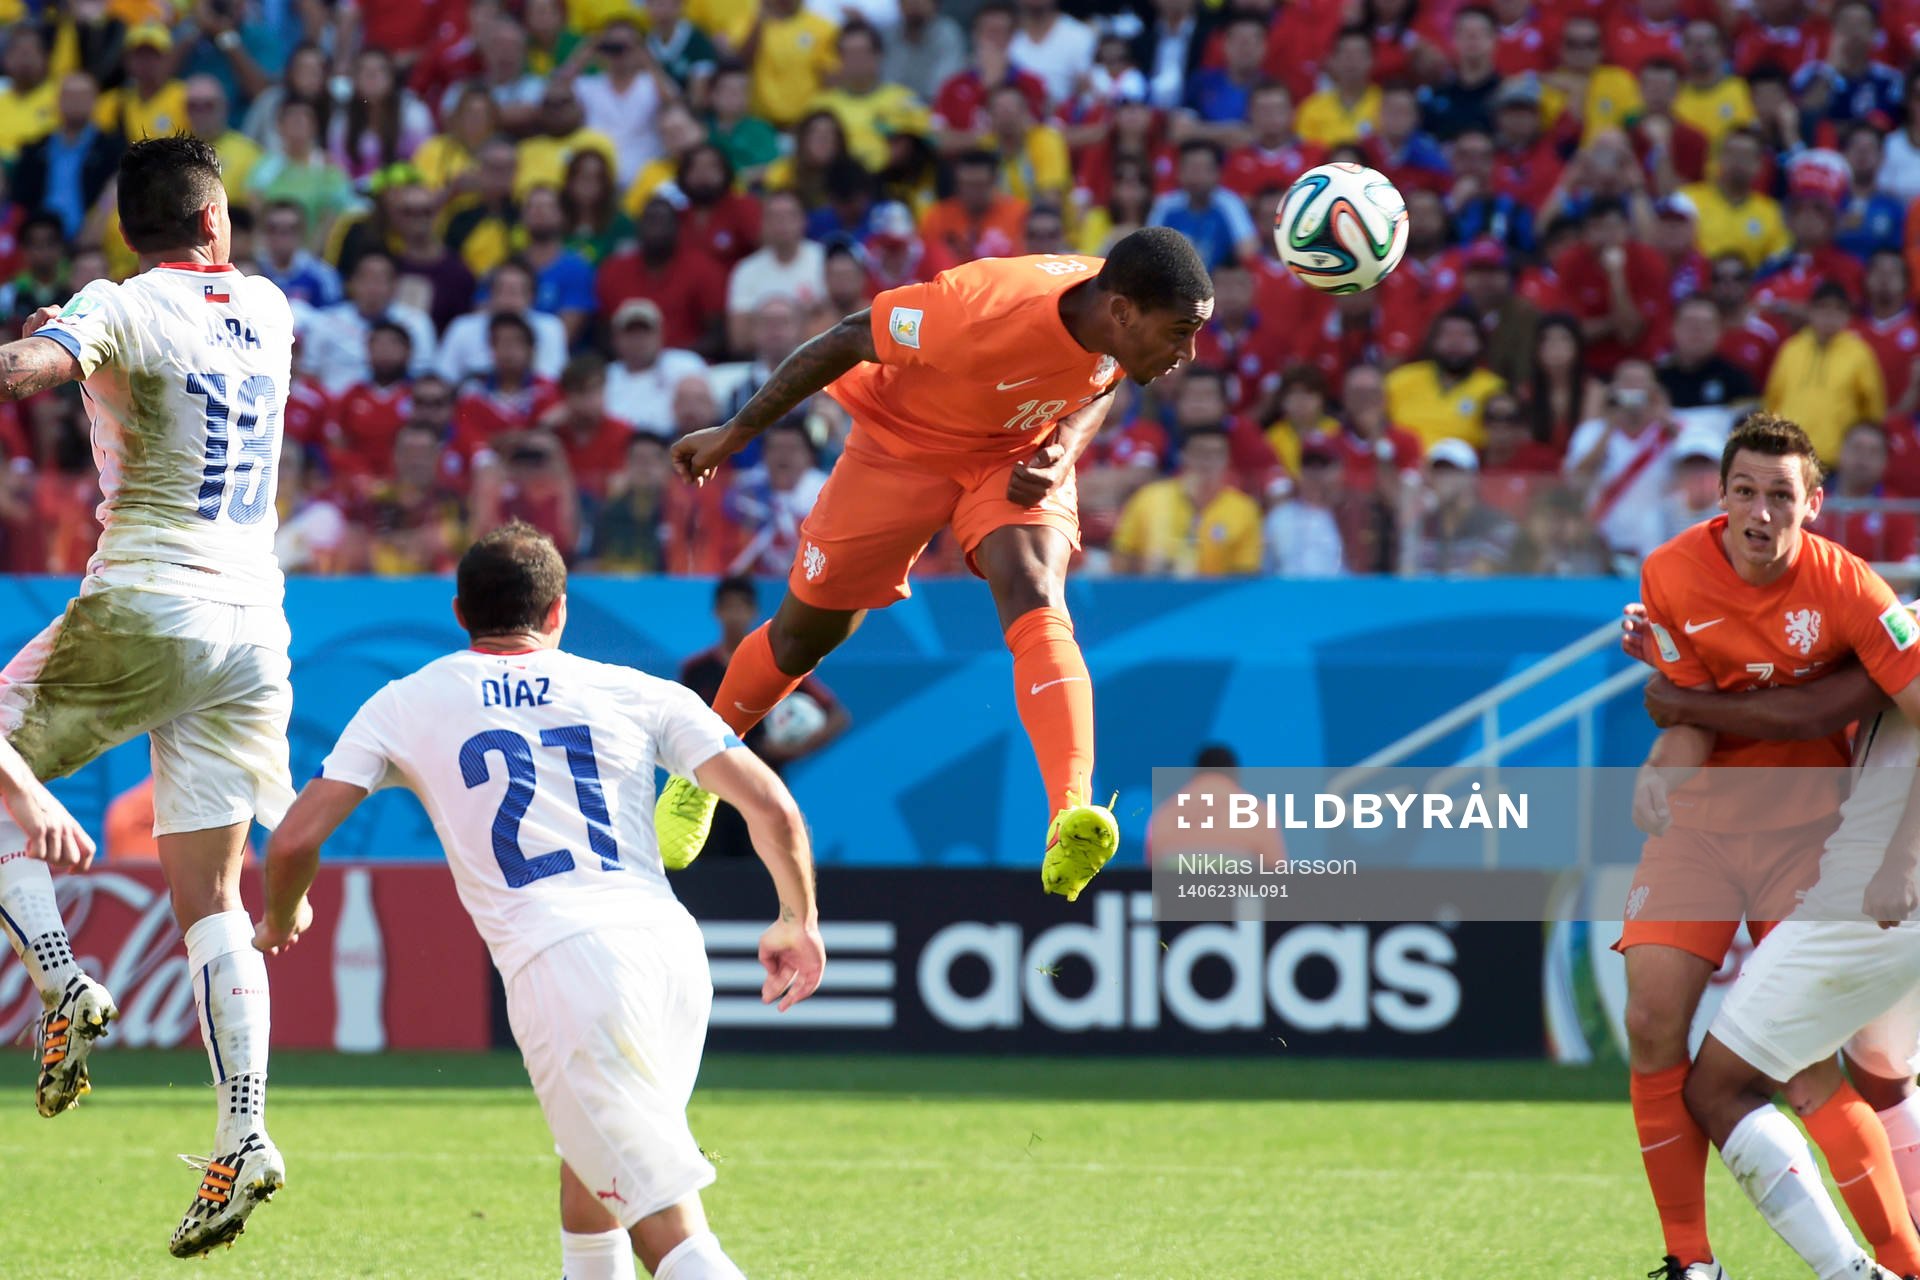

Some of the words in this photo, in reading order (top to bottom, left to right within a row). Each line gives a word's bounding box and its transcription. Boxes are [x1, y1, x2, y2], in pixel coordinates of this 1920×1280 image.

[205, 317, 262, 350] JARA
[186, 373, 279, 525] 18
[1003, 399, 1067, 430] 18
[481, 672, 553, 708] DÍAZ
[459, 724, 625, 888] 21
[917, 890, 1462, 1032] adidas
